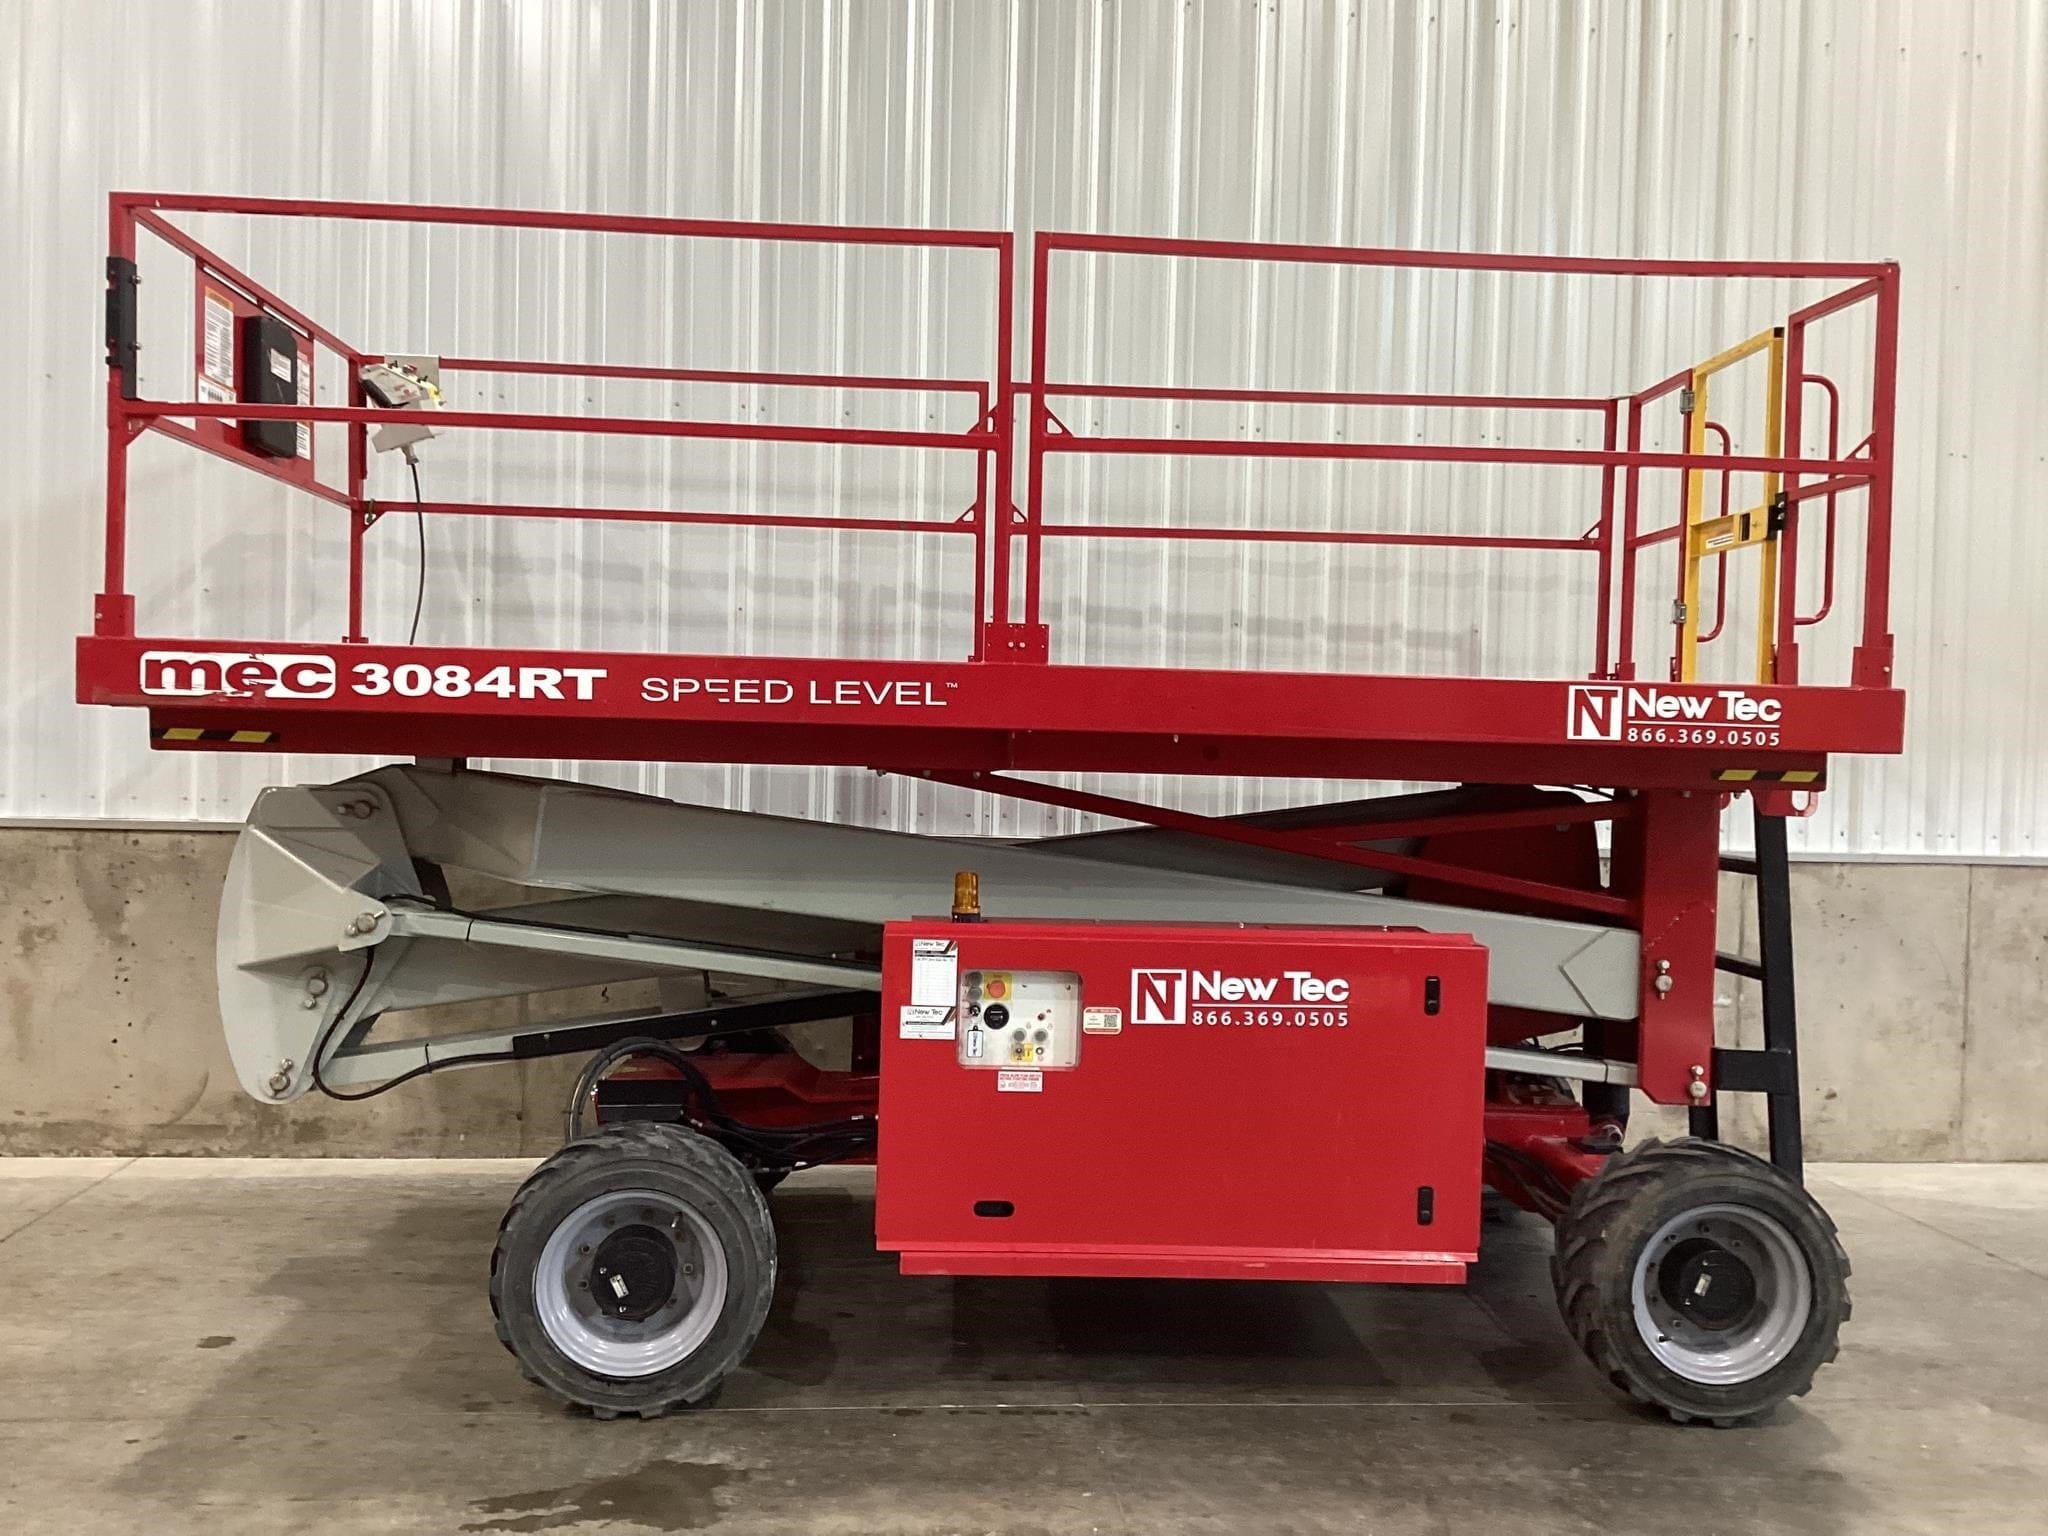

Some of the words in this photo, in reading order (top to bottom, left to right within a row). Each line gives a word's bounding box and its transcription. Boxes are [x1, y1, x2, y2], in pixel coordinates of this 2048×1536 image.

[144, 656, 334, 696] mec
[350, 662, 608, 700] 3084RT
[640, 676, 794, 704] SPEED
[1627, 687, 1713, 719] New
[1717, 690, 1782, 722] Tec
[1627, 727, 1780, 746] 866.369.0505
[1192, 970, 1278, 1001] New
[1283, 970, 1350, 1002] Tec
[1192, 1010, 1348, 1027] 866.369.0505
